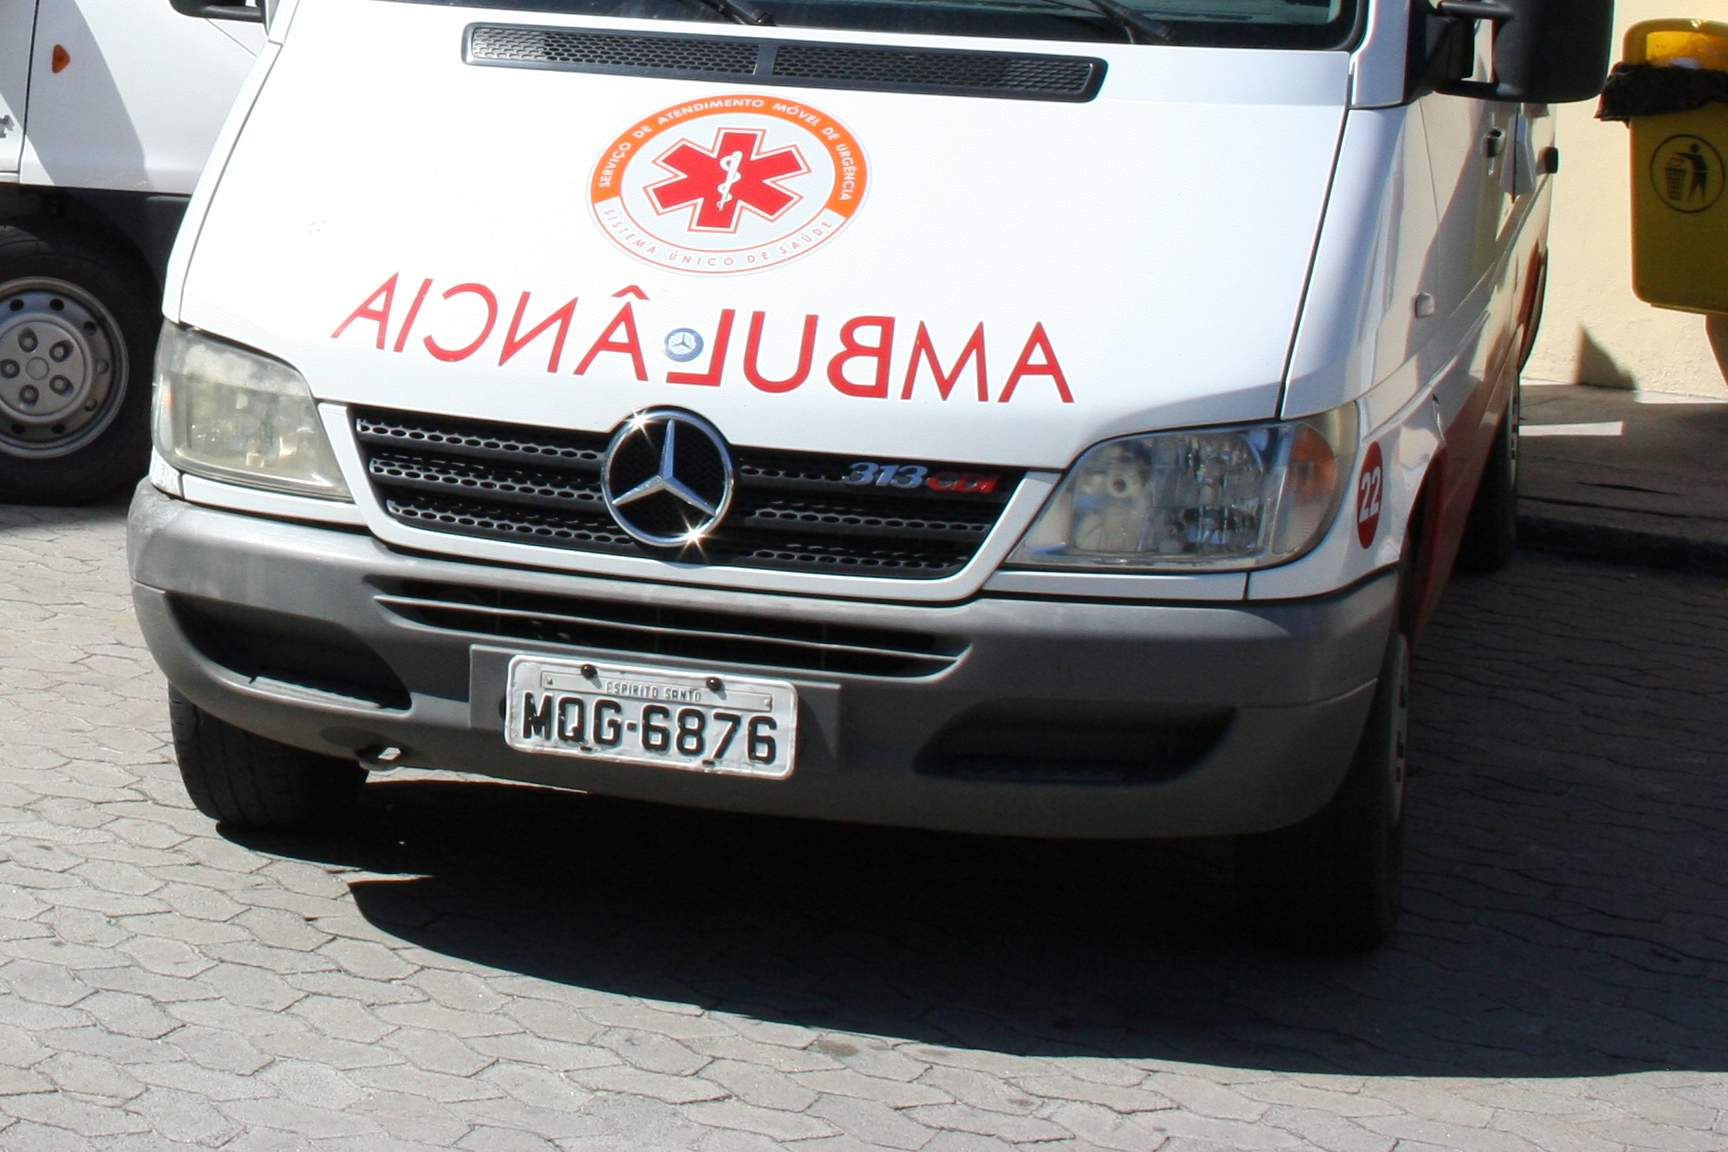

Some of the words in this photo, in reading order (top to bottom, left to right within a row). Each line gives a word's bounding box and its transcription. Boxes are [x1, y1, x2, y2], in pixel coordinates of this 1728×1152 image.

[599, 142, 632, 188] SERVIÇO
[633, 125, 652, 140] DE
[658, 99, 765, 125] ATENDIMENTO
[772, 101, 821, 128] MÓVEL
[821, 126, 840, 141] DE
[836, 144, 856, 201] URGÊNCIA
[603, 209, 657, 254] SISTEMA
[668, 250, 735, 267] ÚNICO
[747, 251, 769, 264] DE
[779, 220, 834, 255] SAÚDE
[847, 461, 928, 489] 313
[1359, 466, 1382, 523] 22
[607, 680, 659, 699] ESPIRITO
[665, 687, 702, 702] SANTO
[523, 691, 778, 765] MQG-6876
